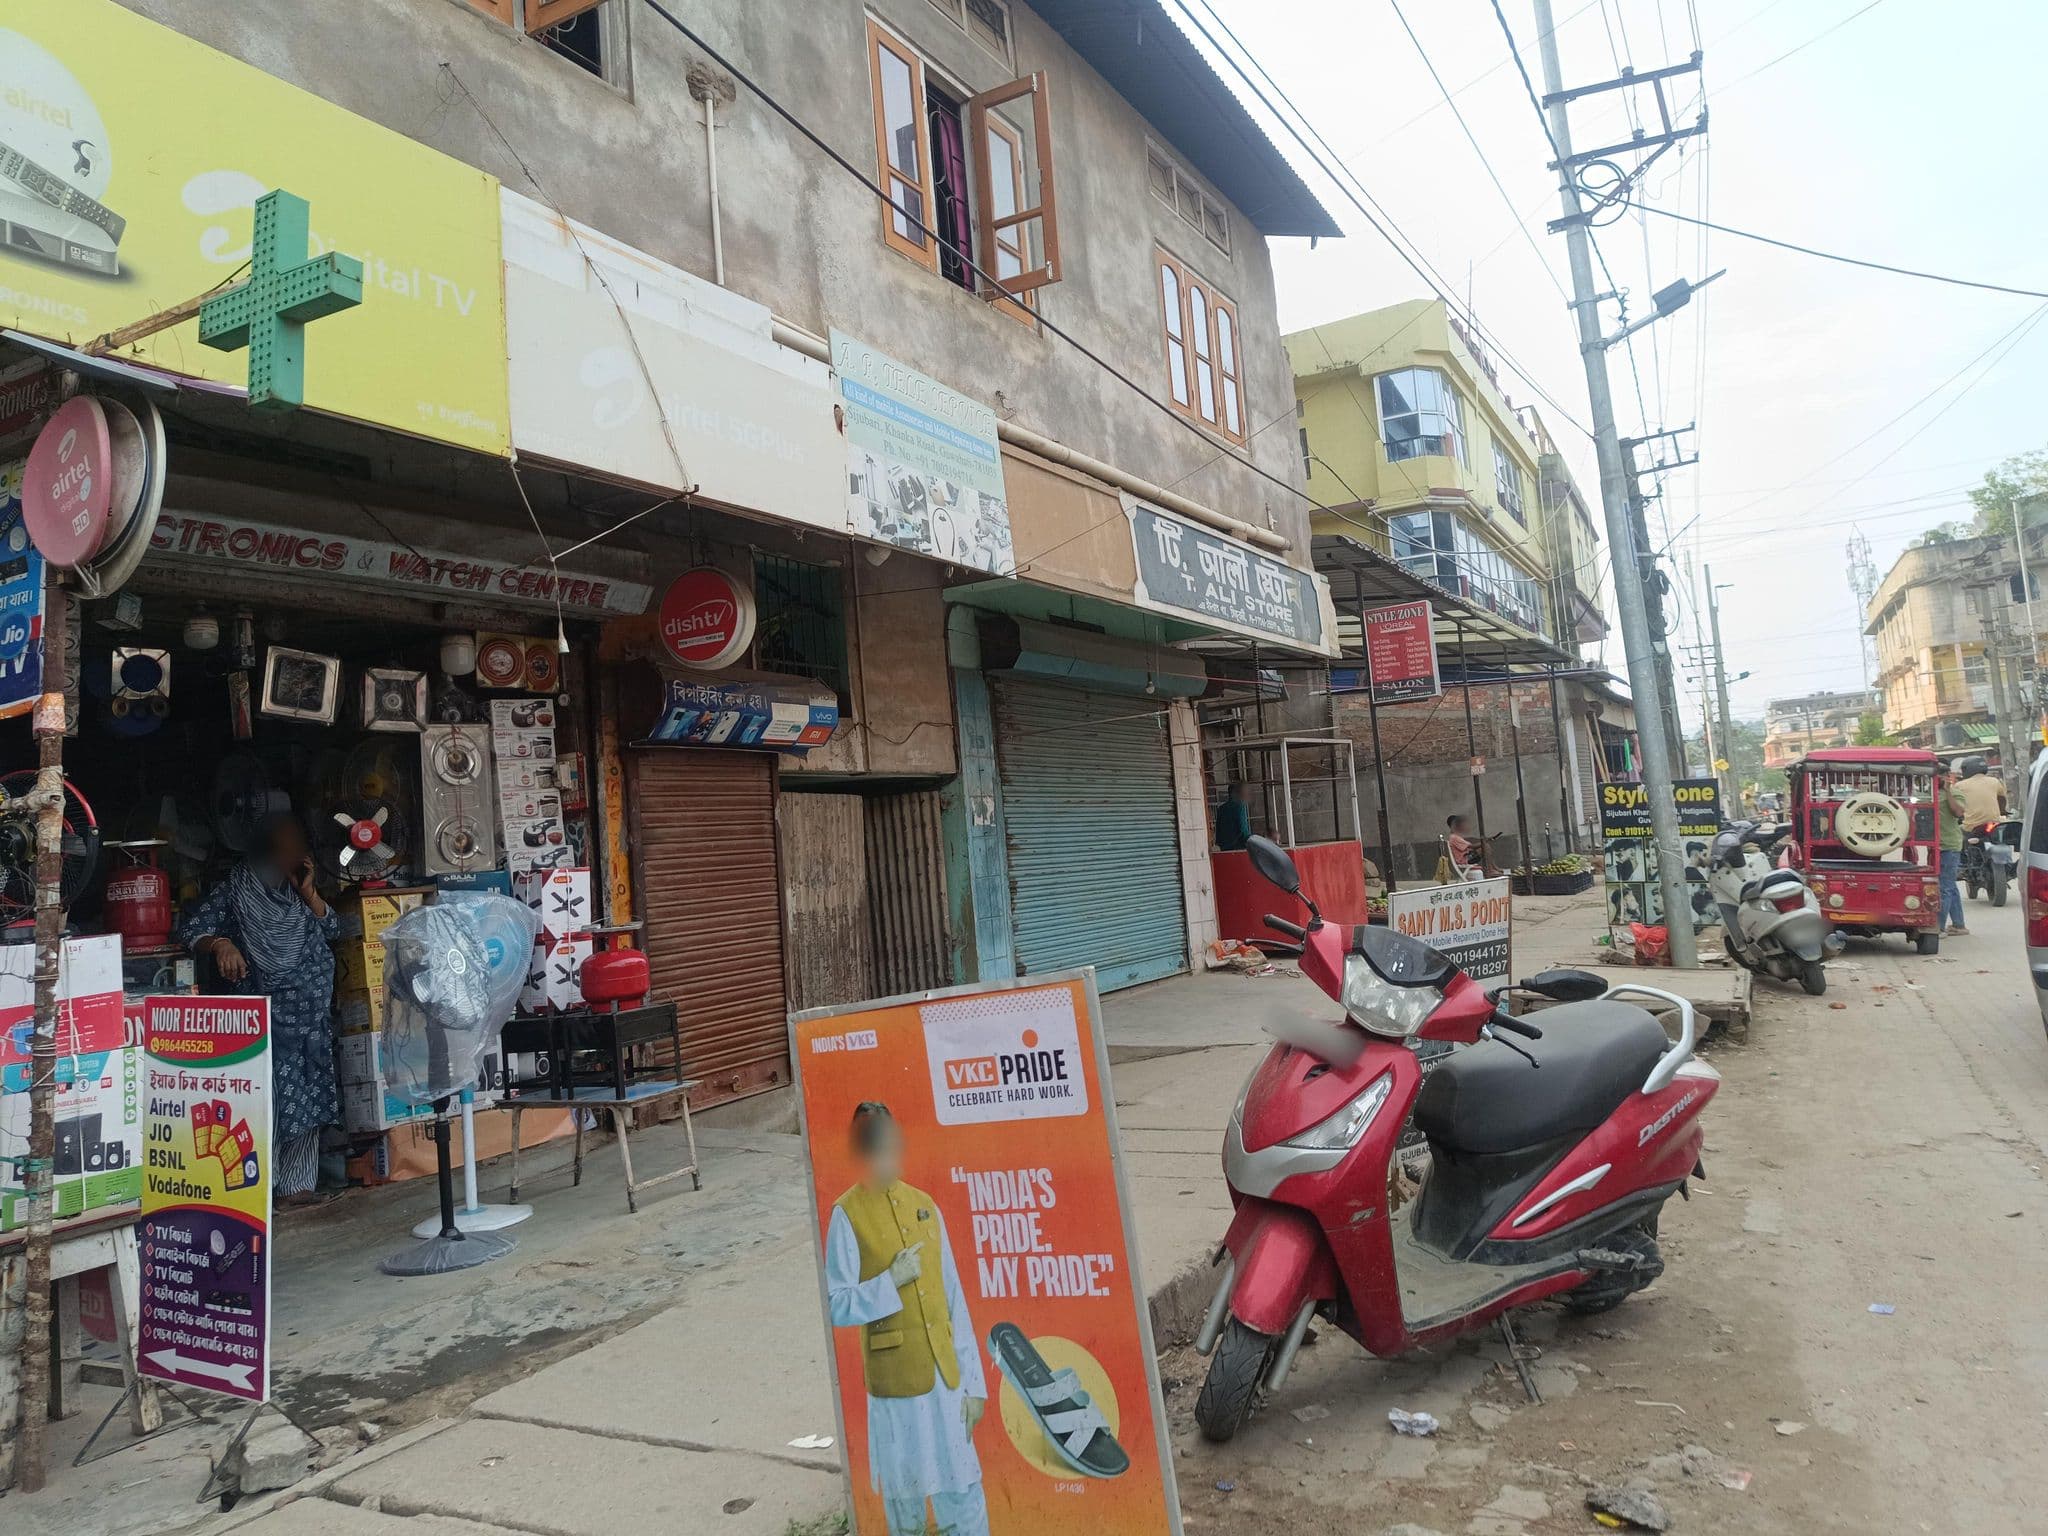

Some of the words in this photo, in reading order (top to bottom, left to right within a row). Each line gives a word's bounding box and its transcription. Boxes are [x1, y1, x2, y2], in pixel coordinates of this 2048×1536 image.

[4, 88, 72, 128] airtel
[428, 272, 476, 316] TV
[52, 454, 92, 500] airtel
[386, 549, 492, 593] WATCH
[499, 565, 610, 610] CENTRE
[1205, 582, 1237, 606] ALI
[1244, 594, 1293, 623] STORE
[1367, 610, 1396, 625] STYLE
[1396, 606, 1424, 621] ZONE
[1, 627, 25, 645] Jio
[1382, 678, 1425, 691] SALON
[815, 711, 833, 721] vivo
[450, 873, 477, 881] BAJAJ
[370, 911, 395, 920] SWIFT
[1398, 909, 1436, 937] SANY
[1440, 904, 1467, 933] M.S.
[1470, 896, 1509, 928] POINT
[1432, 937, 1452, 947] Mobile
[1453, 931, 1481, 944] Repairing
[1481, 928, 1496, 939] Done
[150, 1006, 181, 1034] NOOR
[183, 1007, 260, 1035] ELECTRONICS
[158, 1039, 214, 1054] 9864455258
[811, 1035, 846, 1054] INDIA'S
[848, 1032, 876, 1048] VKC
[948, 1061, 995, 1085] VKC
[1000, 1048, 1069, 1086] PRIDE
[948, 1088, 1004, 1108] CELEBRATE
[1007, 1087, 1035, 1102] HARD
[1039, 1084, 1073, 1100] WORK.
[150, 1098, 185, 1118] Airtel
[149, 1124, 172, 1142] JIO
[149, 1149, 186, 1170] BSNL
[148, 1174, 212, 1200] Vodafone
[156, 1226, 168, 1240] TV
[972, 1211, 1053, 1255] PRIDE.
[155, 1266, 168, 1280] TV
[976, 1257, 1025, 1299] MY
